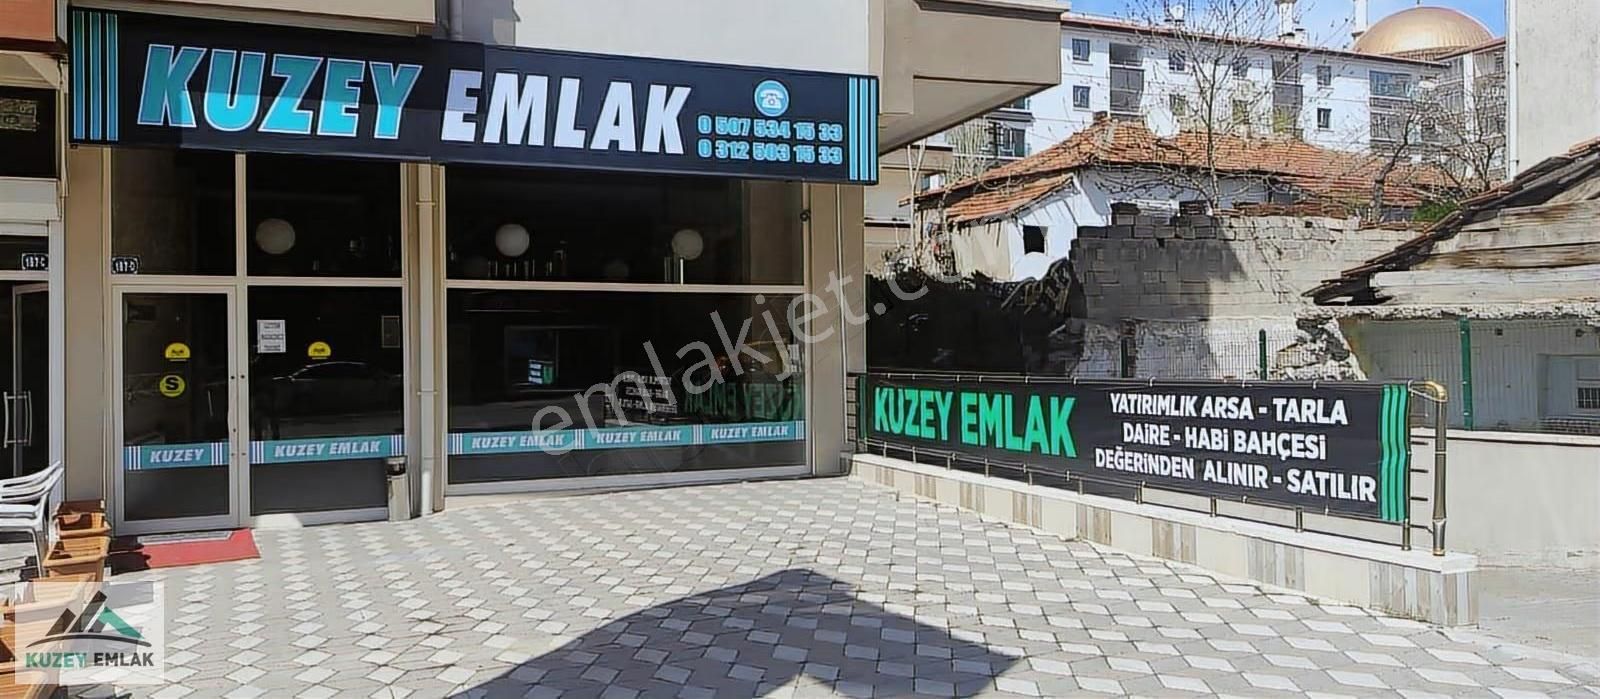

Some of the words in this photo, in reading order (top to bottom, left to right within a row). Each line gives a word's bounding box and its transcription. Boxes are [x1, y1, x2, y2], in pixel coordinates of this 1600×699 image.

[138, 44, 422, 139] KUZEY
[441, 70, 691, 154] EMLAK
[697, 115, 712, 134] 0
[715, 116, 750, 136] 507
[754, 119, 790, 139] 534
[793, 122, 815, 140] 15
[818, 123, 843, 142] 33
[698, 139, 712, 158] 0
[715, 140, 749, 159] 312
[753, 142, 790, 162] 503
[793, 145, 815, 163] 15
[818, 146, 843, 164] 33
[1110, 392, 1199, 417] YATIRIMLIK
[1201, 396, 1254, 420] ARSA
[1273, 397, 1348, 425] TARLA
[711, 427, 747, 439] KUZEY
[751, 425, 789, 437] EMLAK
[875, 386, 953, 441] KUZEY
[960, 392, 1077, 458] EMLAK
[274, 443, 325, 457] KUZEY
[329, 441, 381, 455] EMLAK
[472, 435, 516, 449] KUZEY
[596, 431, 637, 444] KUZEY
[640, 429, 681, 442] EMLAK
[1123, 422, 1171, 446] DAİRE
[1185, 426, 1229, 452] HABİ
[1233, 429, 1326, 461] BAHÇESİ
[150, 448, 204, 463] KUZEY
[1095, 446, 1195, 480] DEĞERİNDEN
[1203, 460, 1269, 489] ALINIR
[1287, 468, 1377, 502] SATILIR
